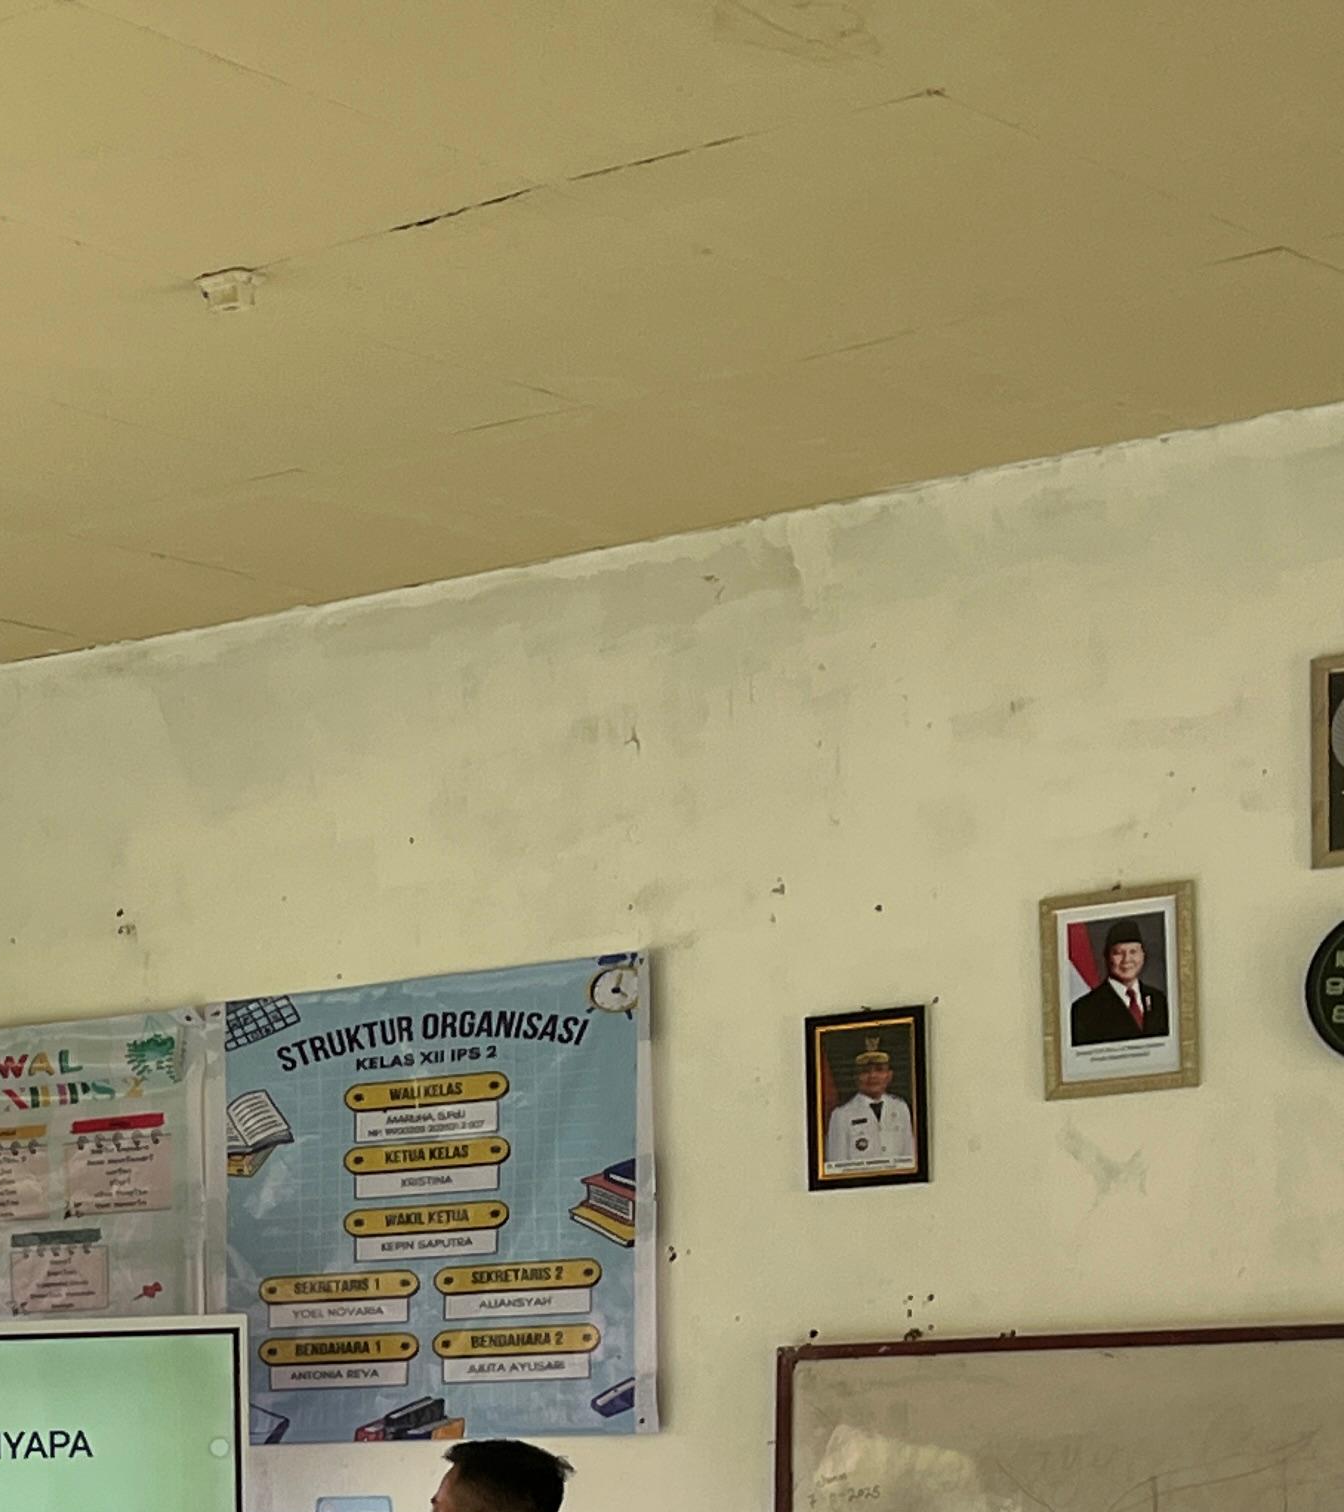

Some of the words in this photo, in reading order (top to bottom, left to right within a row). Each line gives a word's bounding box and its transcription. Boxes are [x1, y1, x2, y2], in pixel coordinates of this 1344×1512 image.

[277, 1016, 413, 1072] STRUKTUR
[422, 1010, 589, 1046] ORGANISASI
[357, 1053, 415, 1071] KELAS
[420, 1050, 444, 1065] XII
[451, 1047, 481, 1062] IPS
[486, 1045, 497, 1059] 2
[389, 1087, 420, 1101] WALI
[424, 1082, 463, 1098] KELAS
[385, 1149, 425, 1164] KETUA
[429, 1145, 469, 1160] KELAS
[385, 1211, 424, 1227] WAKIL
[428, 1209, 469, 1224] KETUA
[418, 1237, 473, 1250] SAPUTRA
[471, 1267, 552, 1284] SEKRETARIS
[555, 1266, 564, 1280] 2
[294, 1278, 370, 1295] SEKRETARIS
[374, 1278, 380, 1290] 1
[295, 1340, 370, 1356] BENDAHARA
[375, 1340, 381, 1353] 1
[471, 1332, 551, 1349] BENDAHARA
[554, 1330, 564, 1345] 2
